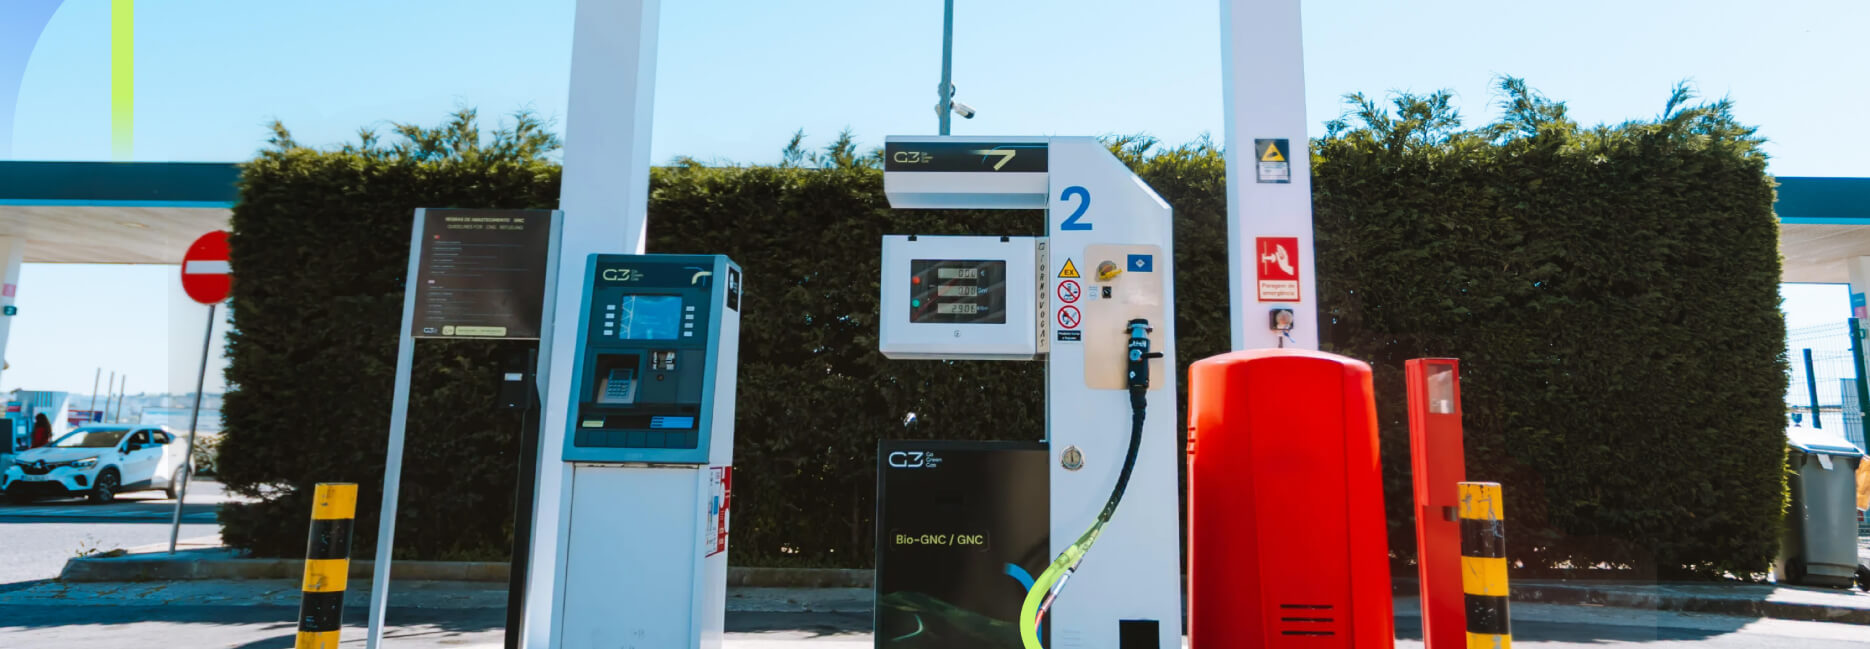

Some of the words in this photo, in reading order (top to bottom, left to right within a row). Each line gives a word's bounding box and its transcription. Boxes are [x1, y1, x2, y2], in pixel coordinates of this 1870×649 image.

[1060, 185, 1093, 231] 2
[888, 451, 924, 468] G3
[895, 533, 947, 545] Bio-GNC
[957, 534, 984, 545] GNC
